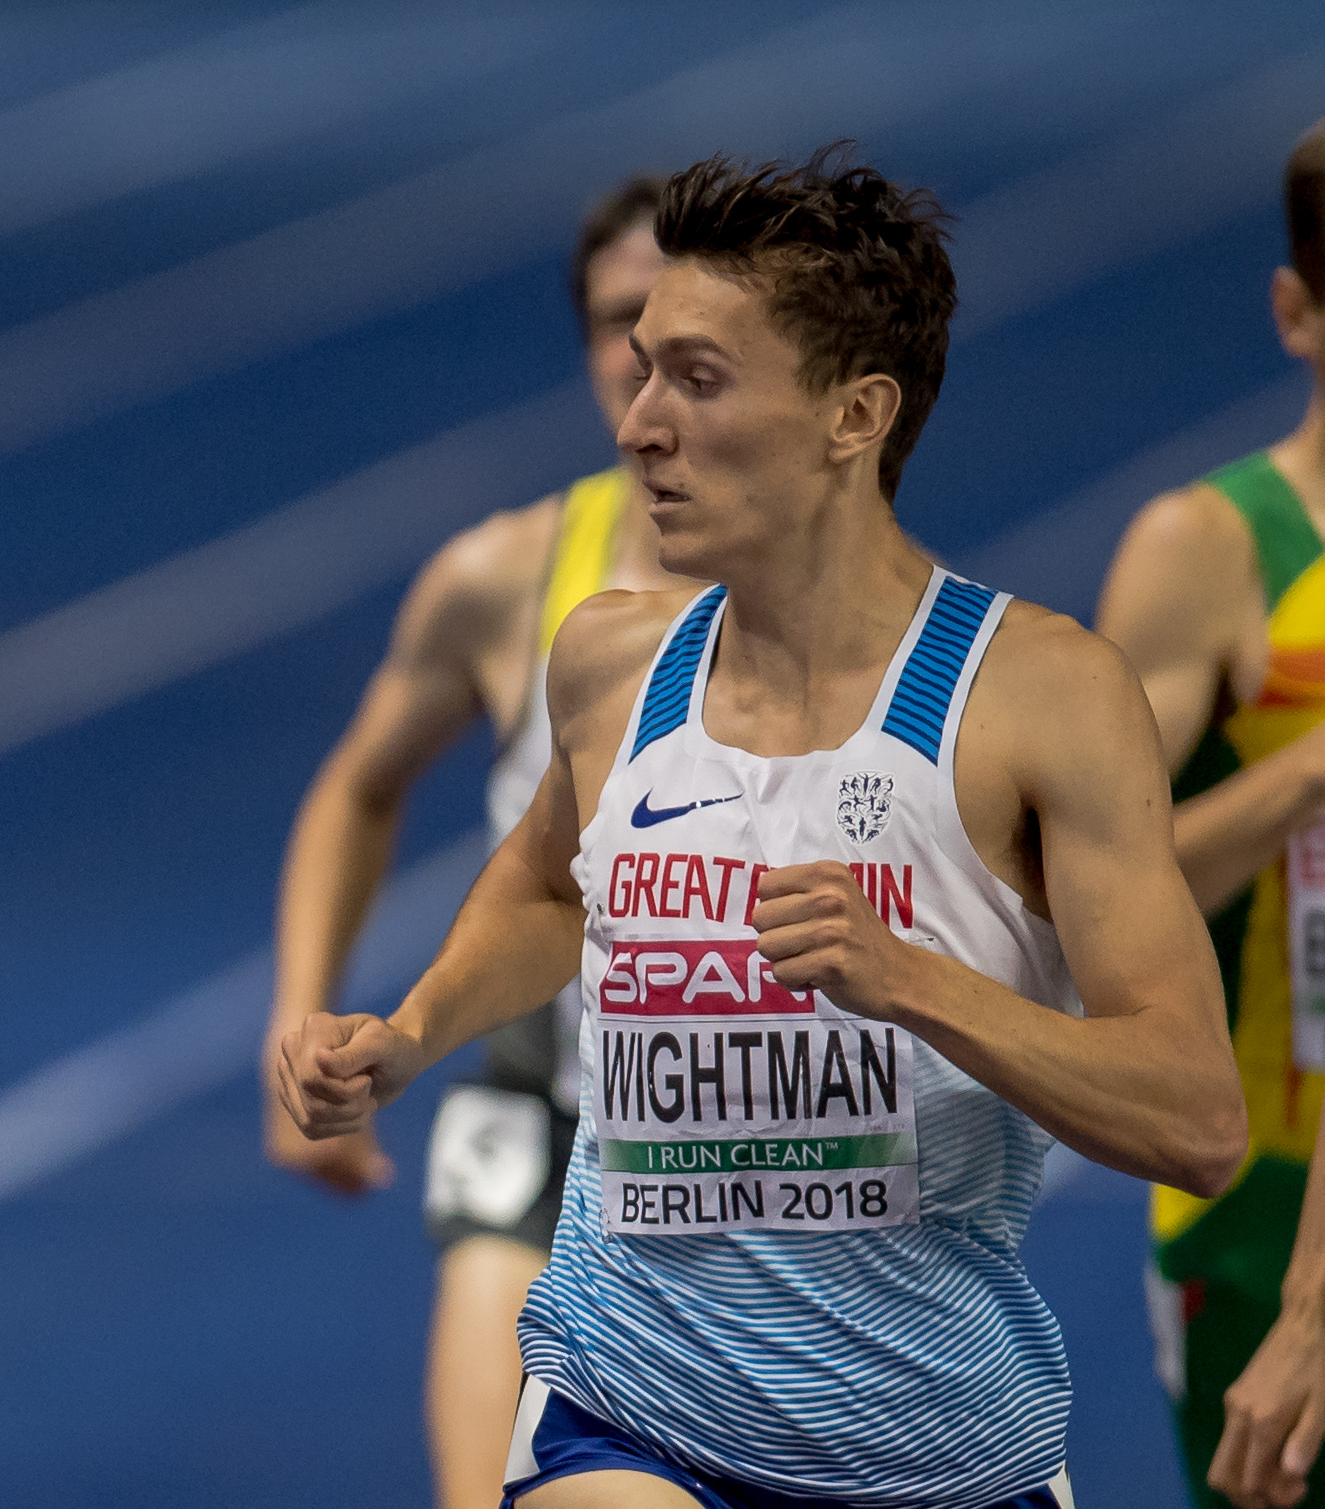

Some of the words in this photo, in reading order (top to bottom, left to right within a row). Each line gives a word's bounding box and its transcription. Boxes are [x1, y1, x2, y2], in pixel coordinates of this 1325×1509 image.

[608, 852, 746, 924] GREAT
[602, 1027, 898, 1124] WIGHTMAN
[647, 1145, 654, 1168] I
[661, 1144, 721, 1169] RUN
[620, 1179, 765, 1225] BERLIN
[778, 1178, 889, 1221] 2018
